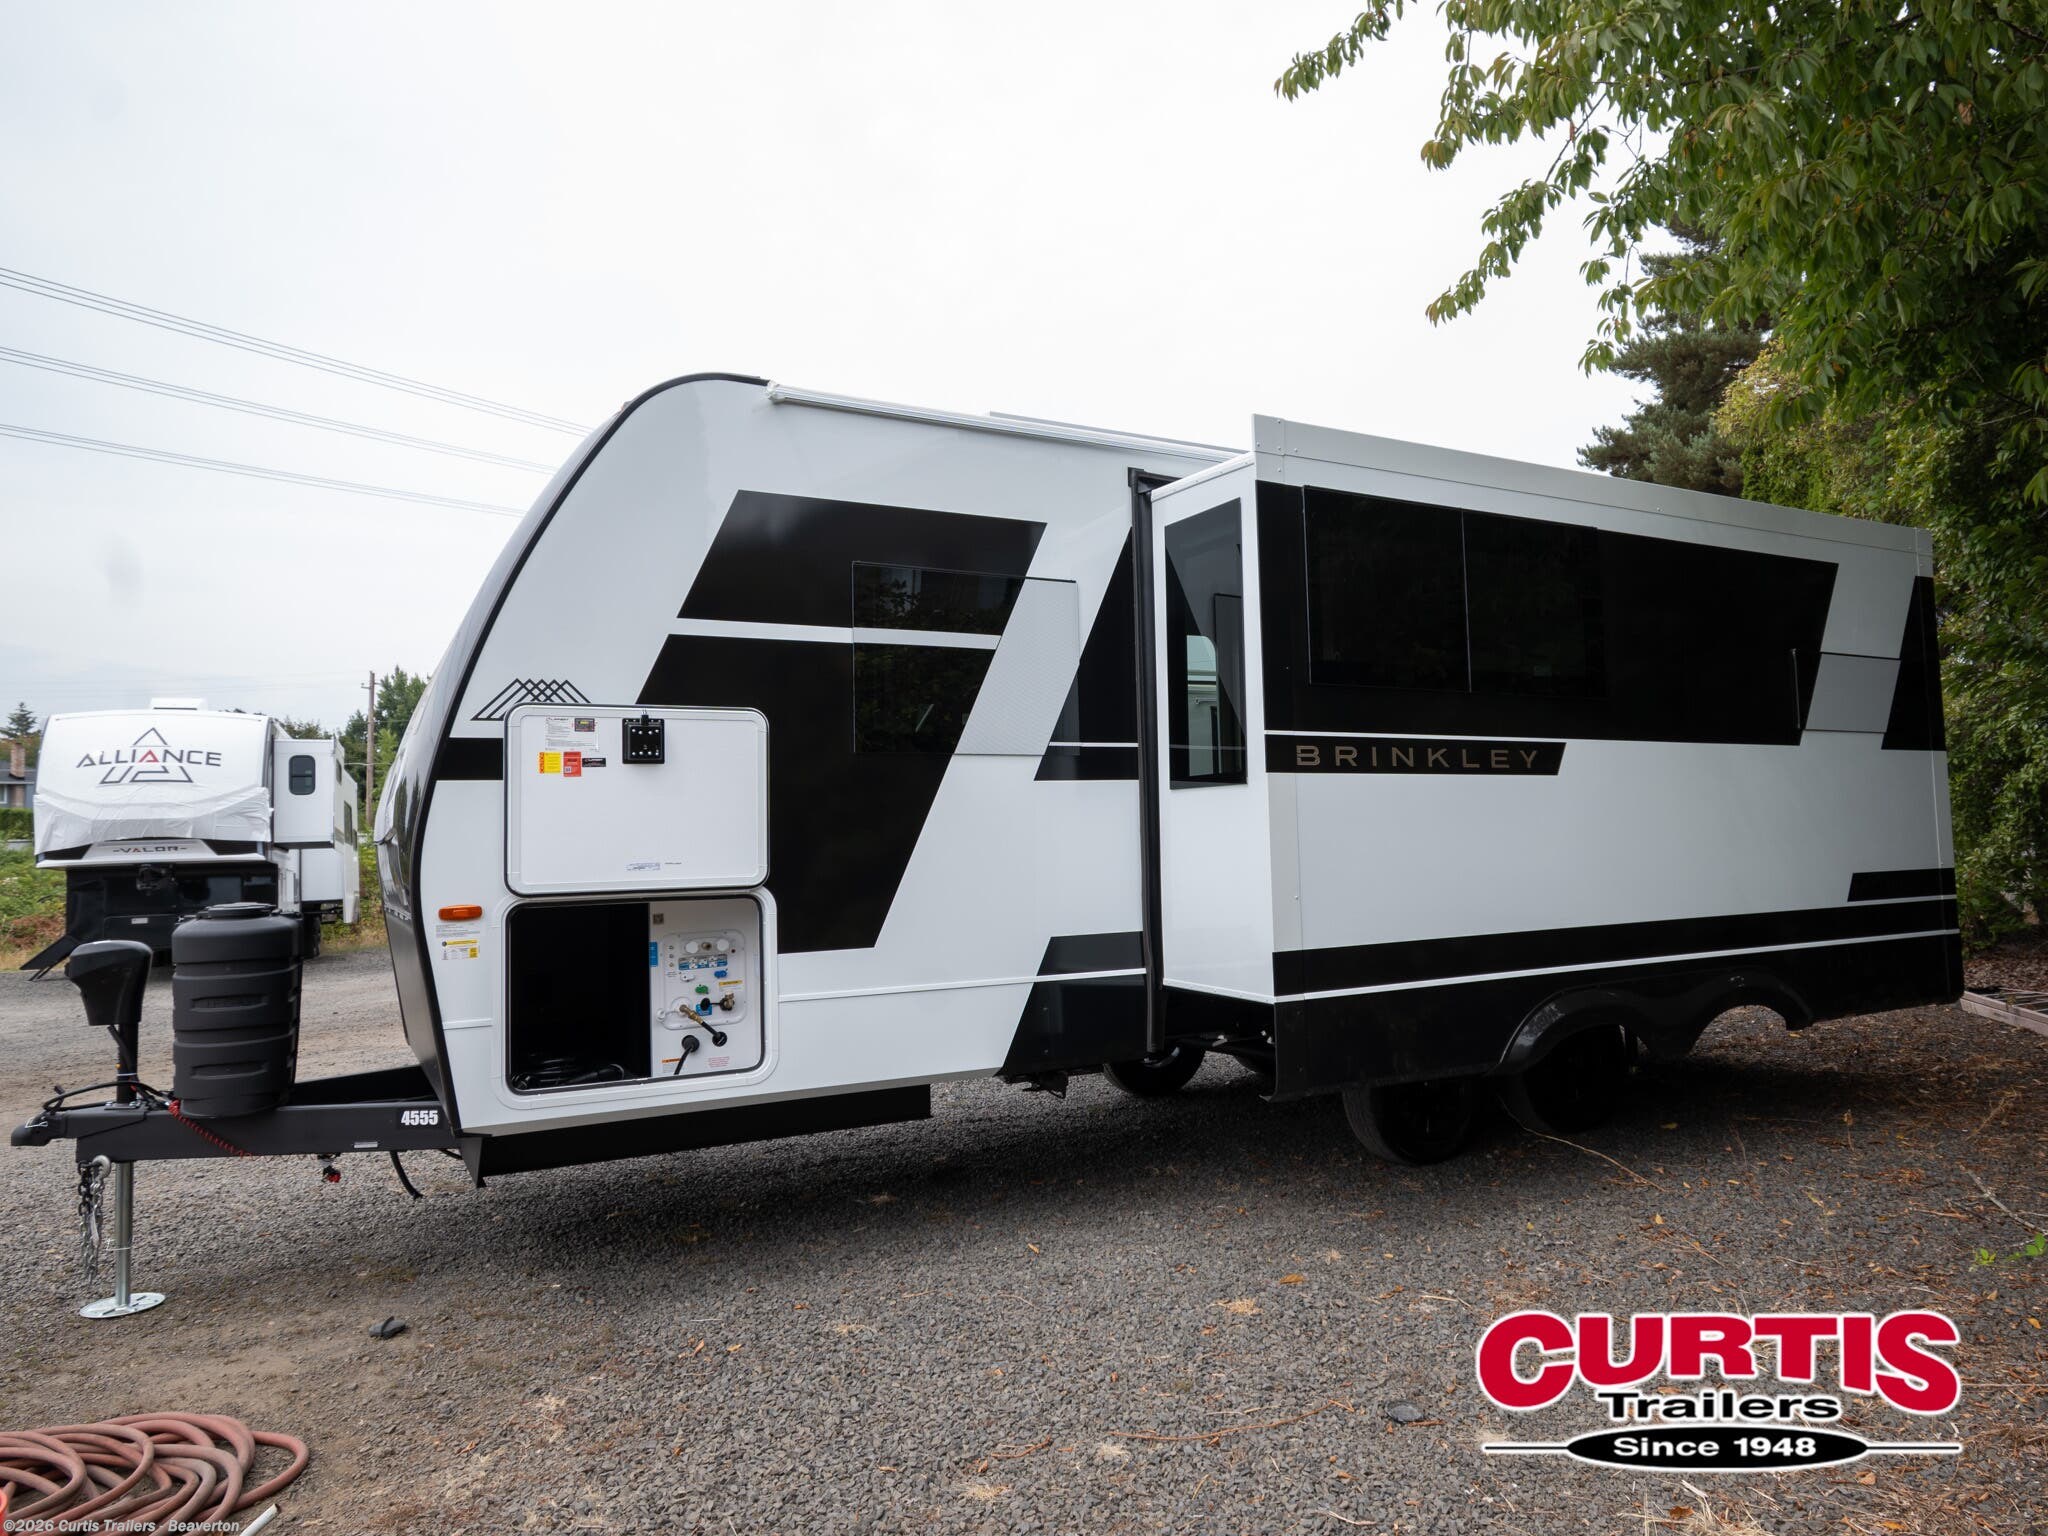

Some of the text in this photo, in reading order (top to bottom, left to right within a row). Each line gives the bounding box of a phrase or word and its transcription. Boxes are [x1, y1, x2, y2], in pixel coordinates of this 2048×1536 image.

[76, 748, 222, 768] ALLIANCE
[1295, 744, 1538, 769] BRINKLEY
[400, 1109, 439, 1126] 4555
